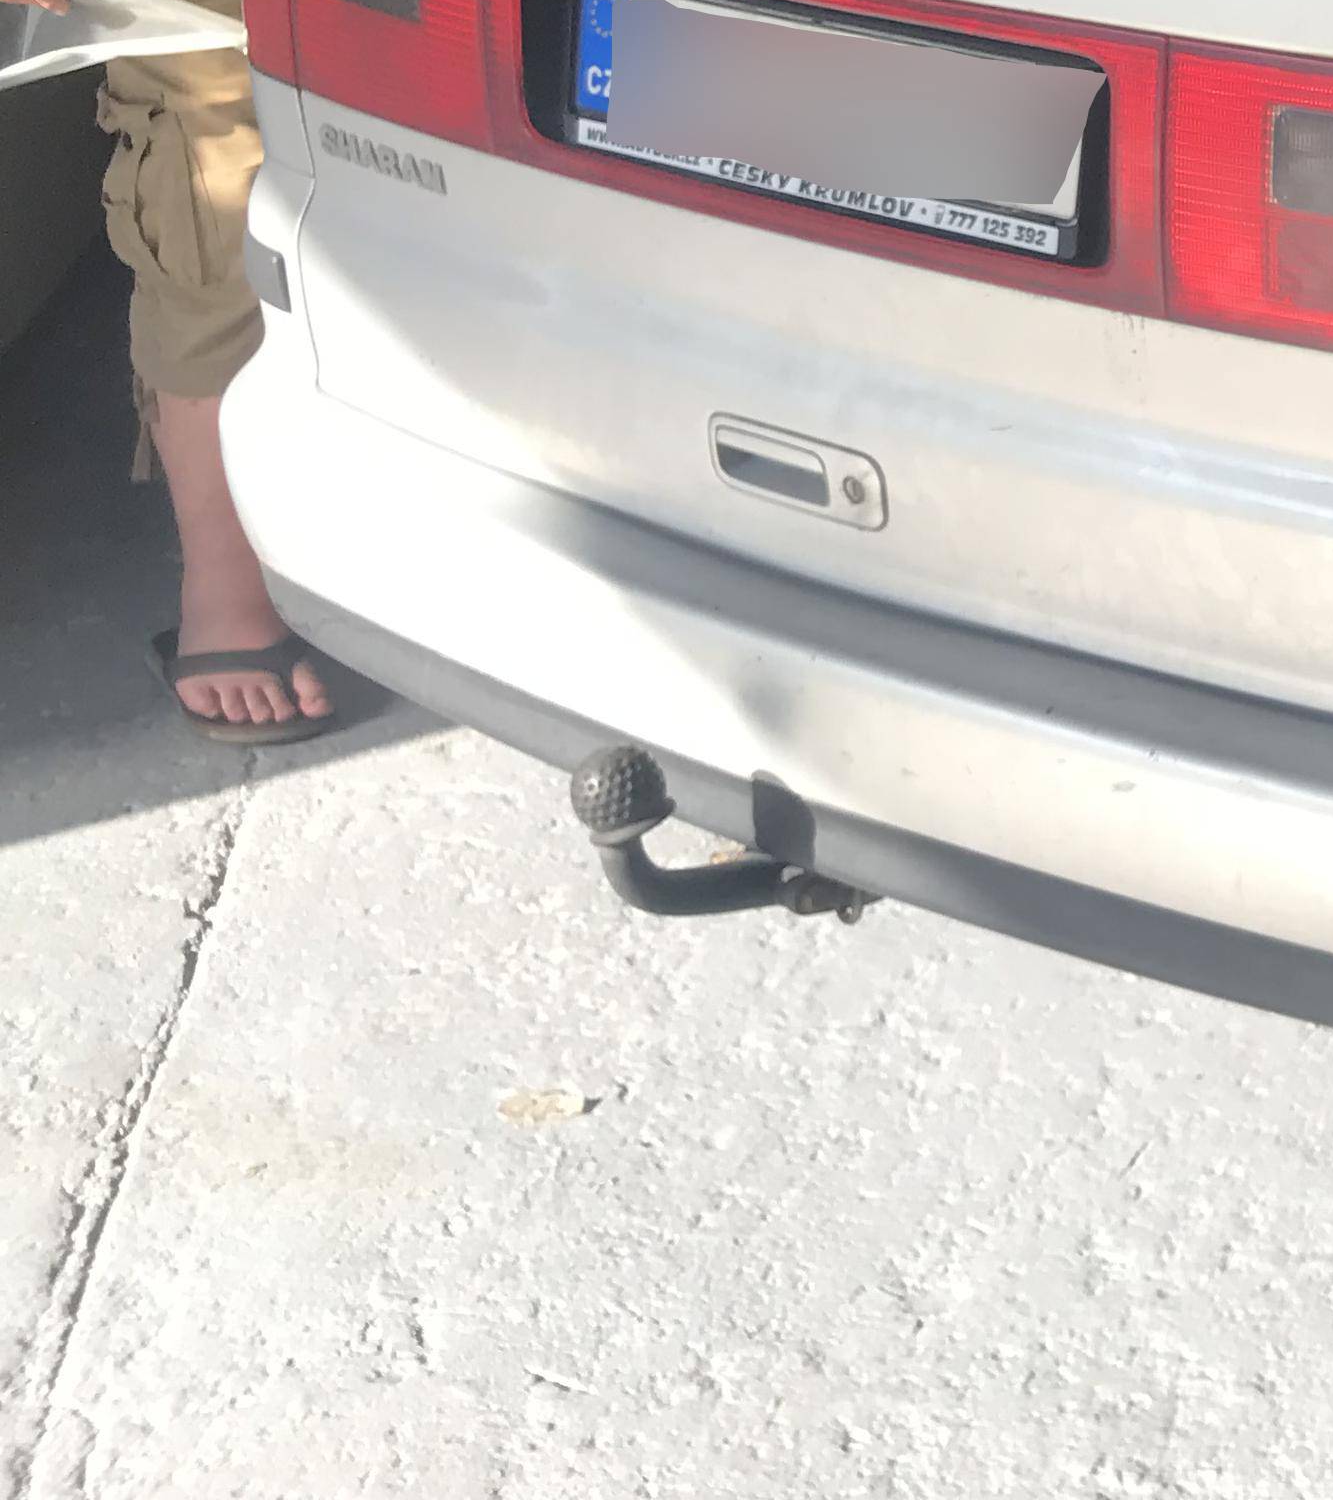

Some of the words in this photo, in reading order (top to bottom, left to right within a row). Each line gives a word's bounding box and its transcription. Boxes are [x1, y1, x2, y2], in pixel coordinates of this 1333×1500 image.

[318, 122, 448, 196] SHARAN
[947, 209, 979, 230] 777
[981, 217, 1012, 238] 125
